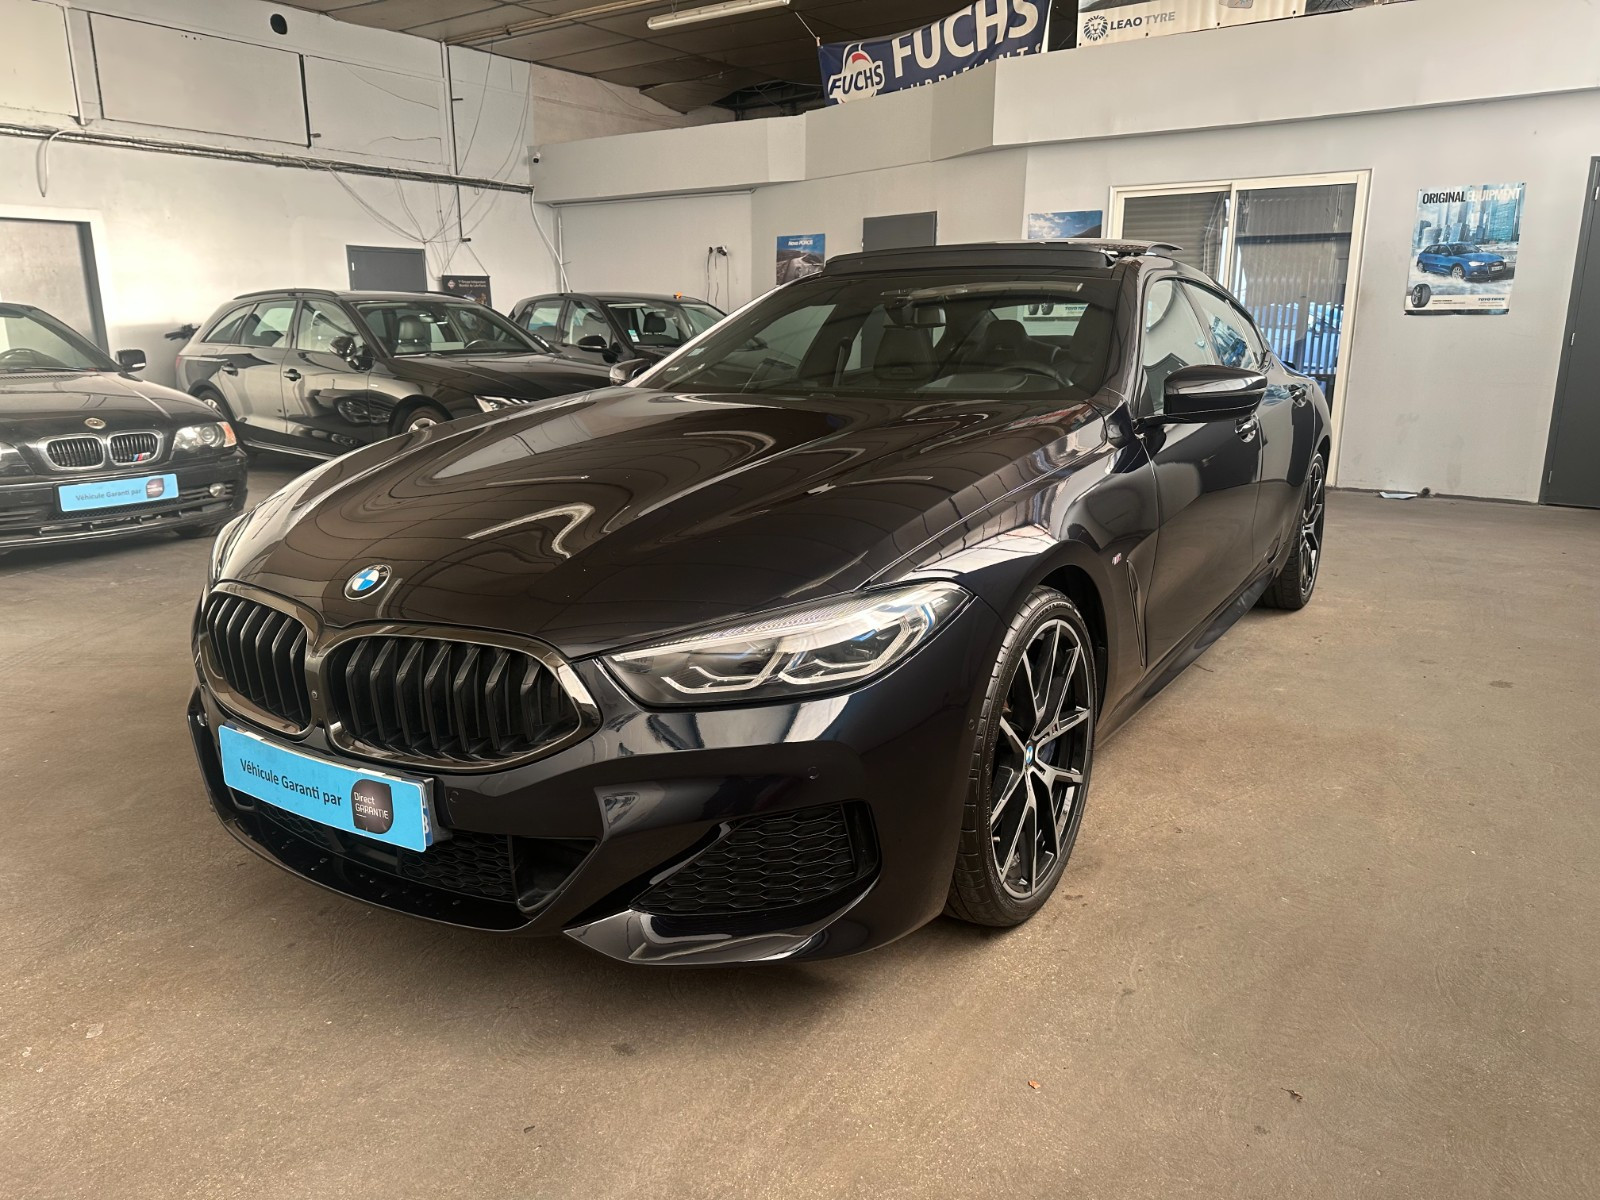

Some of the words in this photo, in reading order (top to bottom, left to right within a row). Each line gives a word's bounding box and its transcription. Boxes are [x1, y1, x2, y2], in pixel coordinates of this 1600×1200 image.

[1110, 16, 1143, 31] LEAO
[1144, 11, 1176, 25] TYRE
[892, 0, 1039, 79] FUCHS
[829, 64, 883, 96] FUCHS
[1422, 191, 1466, 204] ORIGINAL
[1467, 187, 1521, 203] EQUIPMENT
[240, 758, 280, 786] Véhicule
[281, 775, 320, 800] Garanti
[322, 791, 342, 806] par
[353, 791, 376, 805] Direct
[355, 802, 389, 820] GARANTIE
